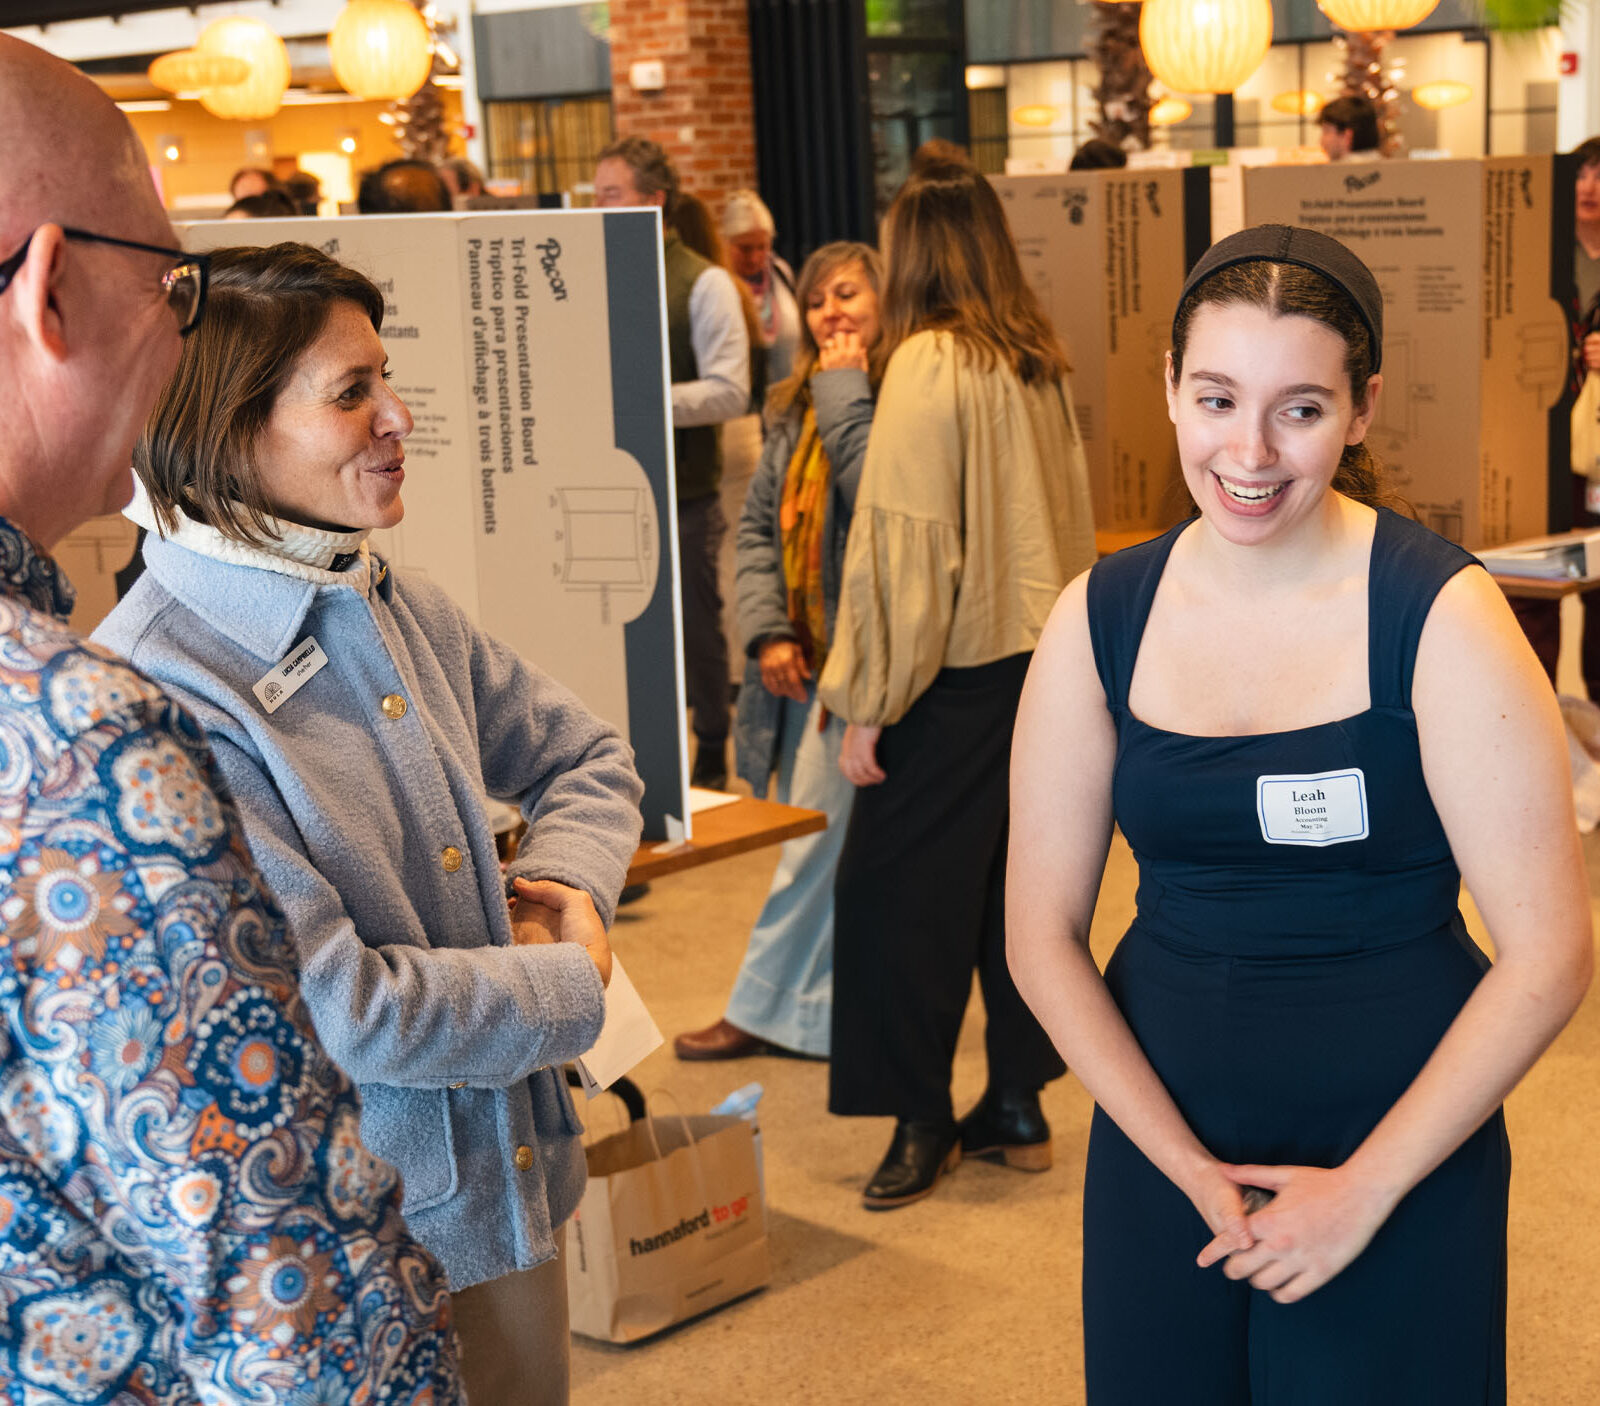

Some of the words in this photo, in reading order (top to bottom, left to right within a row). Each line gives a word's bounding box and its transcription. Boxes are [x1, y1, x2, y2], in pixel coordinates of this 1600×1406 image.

[468, 239, 483, 310] Panneau
[511, 237, 529, 299] Tri-Fold
[536, 237, 568, 301] Pacon
[379, 326, 419, 338] attants
[489, 306, 507, 343] para
[472, 316, 490, 404] d'affichage
[515, 305, 533, 411] Presentation
[492, 349, 514, 474] presentaciones
[478, 425, 495, 463] trois
[521, 417, 539, 466] Board
[481, 468, 497, 535] battants
[1292, 789, 1326, 802] Leah
[1294, 807, 1327, 815] Bloom
[630, 1207, 710, 1256] hannaford
[712, 1205, 729, 1222] to
